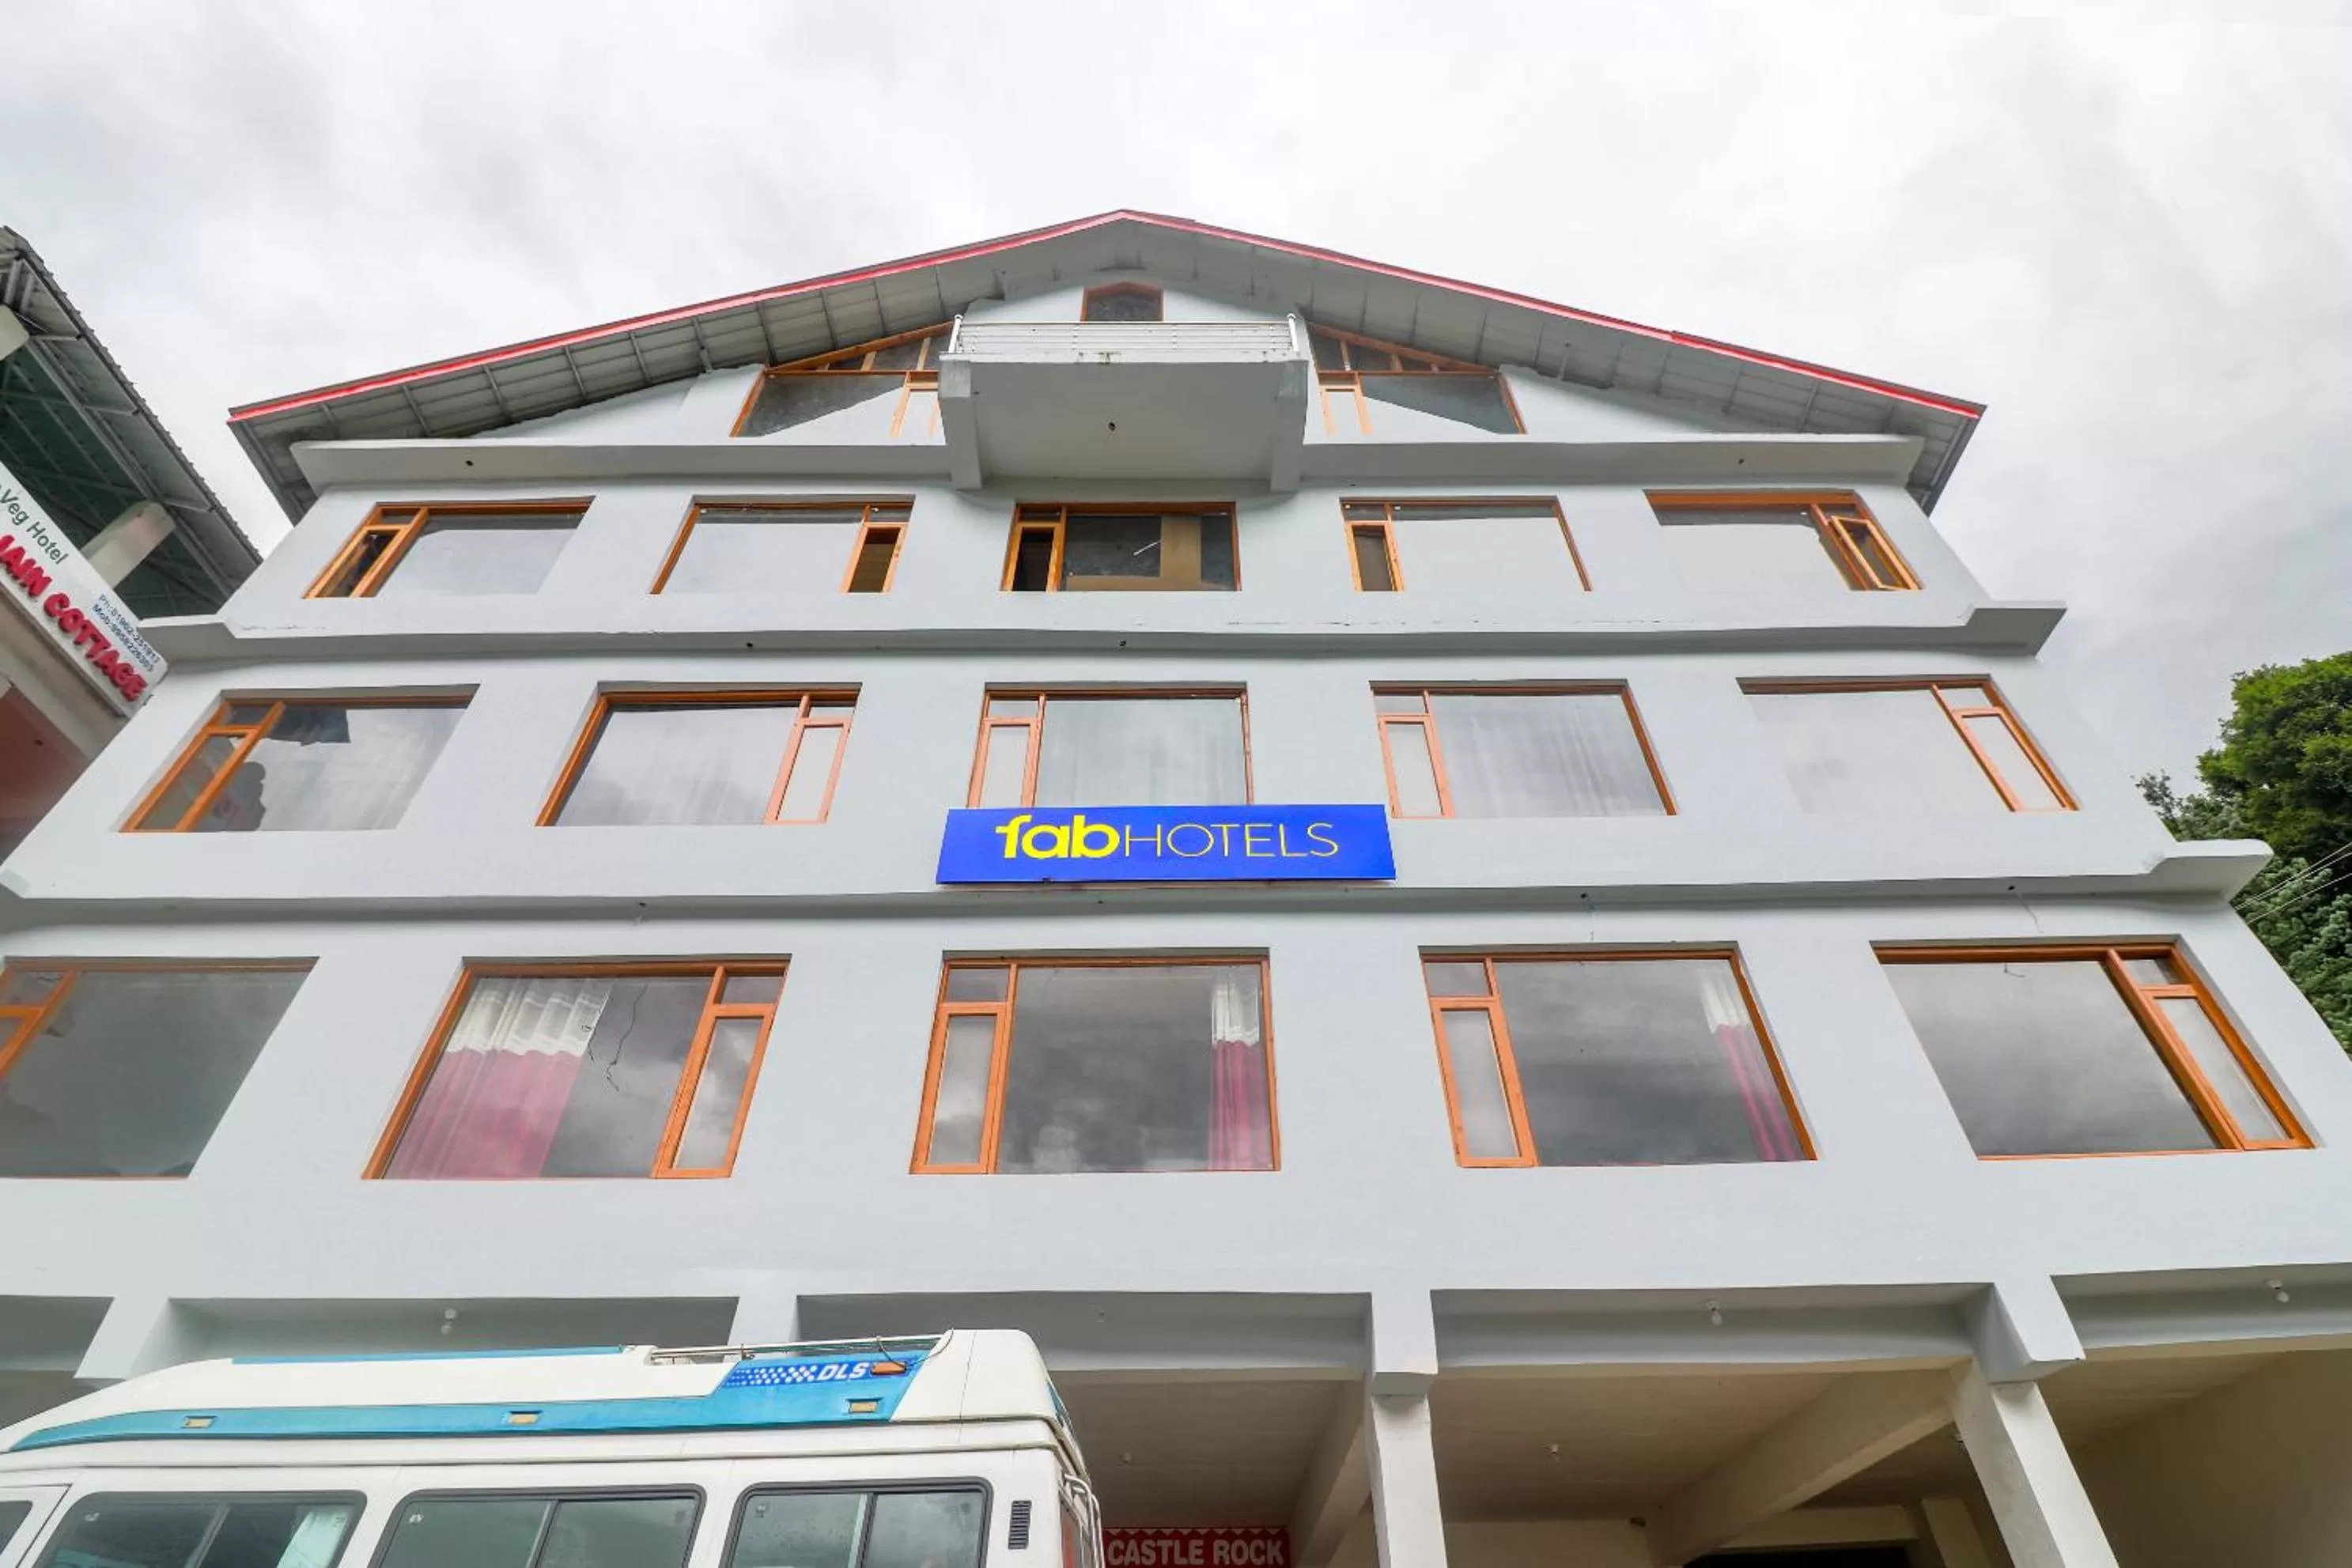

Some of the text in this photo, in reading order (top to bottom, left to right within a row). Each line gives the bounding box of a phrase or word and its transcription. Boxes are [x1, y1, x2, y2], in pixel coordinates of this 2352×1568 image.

[0, 489, 70, 565] Veg Hotel
[43, 593, 148, 701] COTTAGE
[816, 1362, 870, 1381] DLS
[1108, 1539, 1285, 1566] CASTLE ROCK
